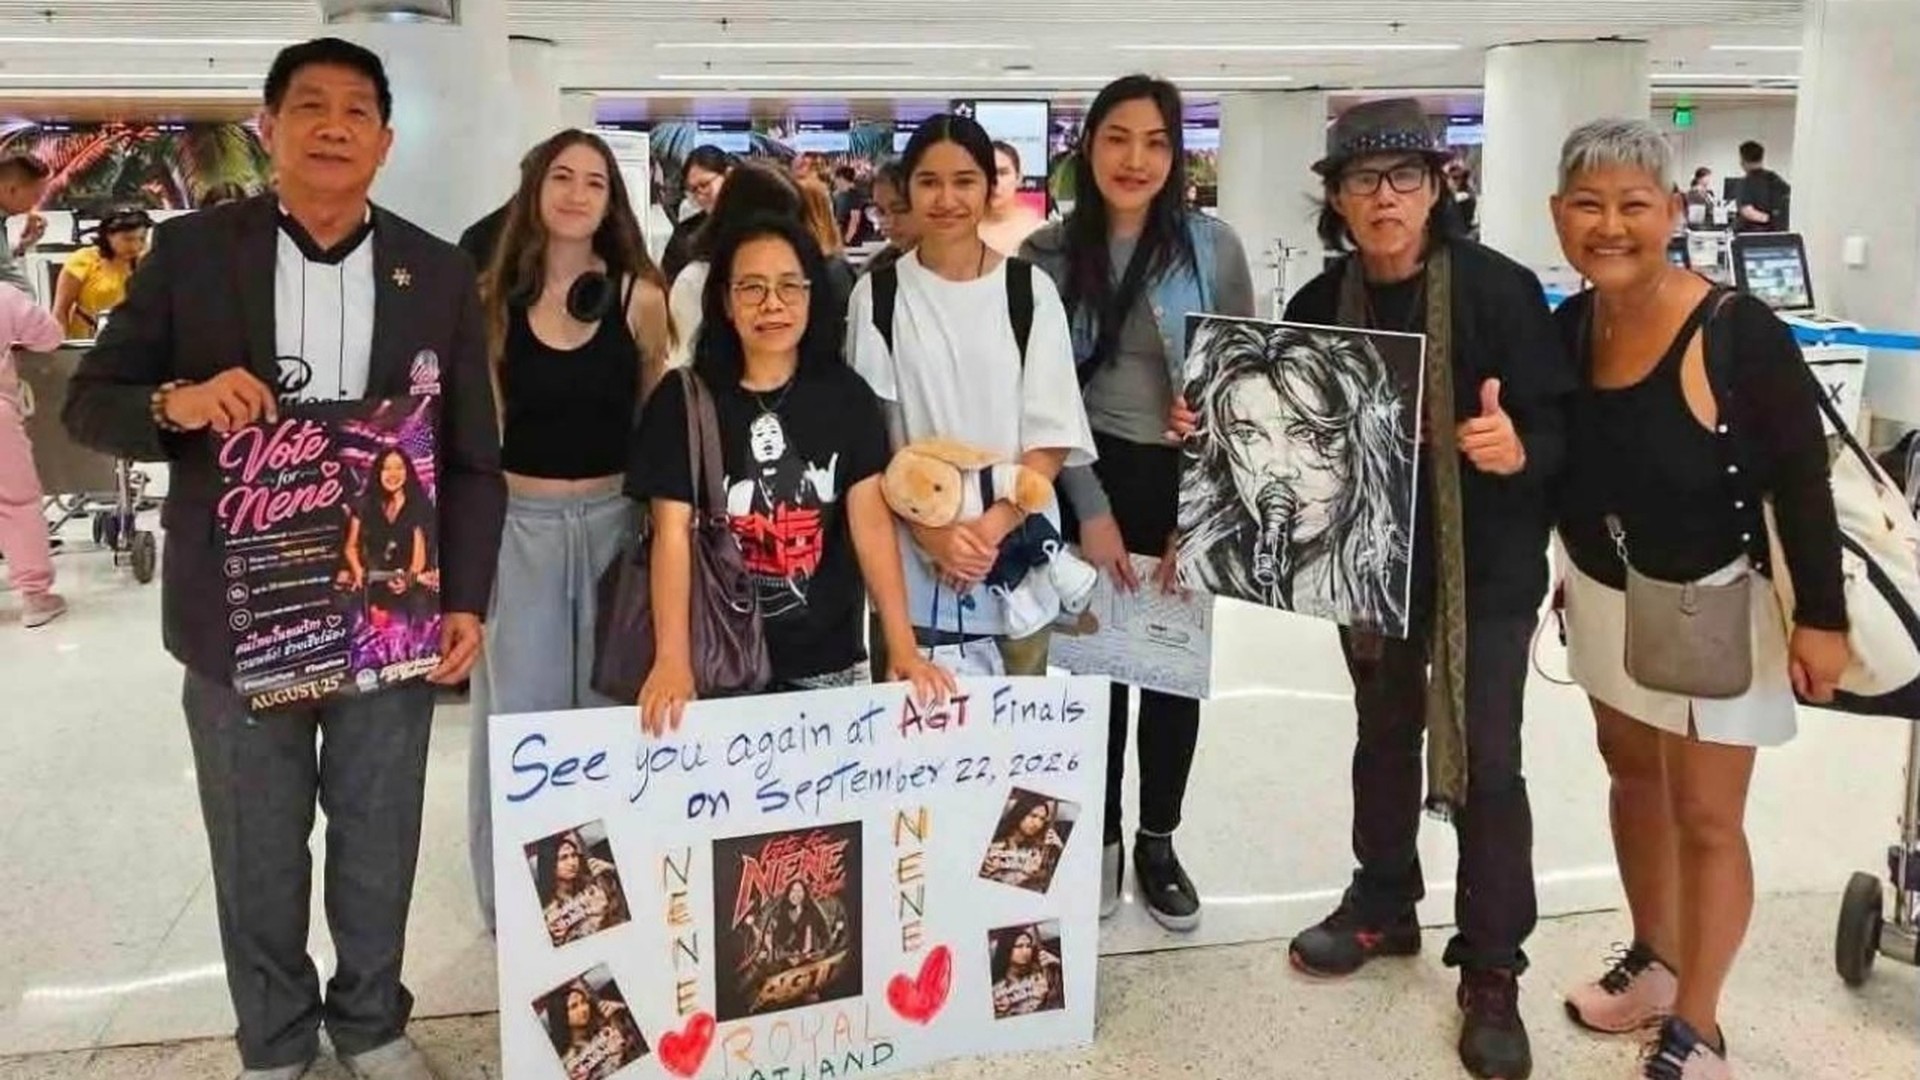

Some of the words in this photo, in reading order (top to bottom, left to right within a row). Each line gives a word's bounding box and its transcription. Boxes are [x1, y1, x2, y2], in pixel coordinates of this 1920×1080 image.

[219, 418, 329, 483] Vote
[272, 468, 301, 493] for
[252, 681, 321, 710] AUGUST
[506, 733, 609, 802] See
[629, 744, 708, 803] you
[726, 712, 831, 779] again
[846, 700, 886, 745] at
[898, 694, 970, 737] AGT
[992, 685, 1086, 726] Finals
[687, 791, 730, 819] on
[955, 755, 996, 784] 22,
[1008, 751, 1079, 777] 2026
[721, 1002, 890, 1078] ROYAL
